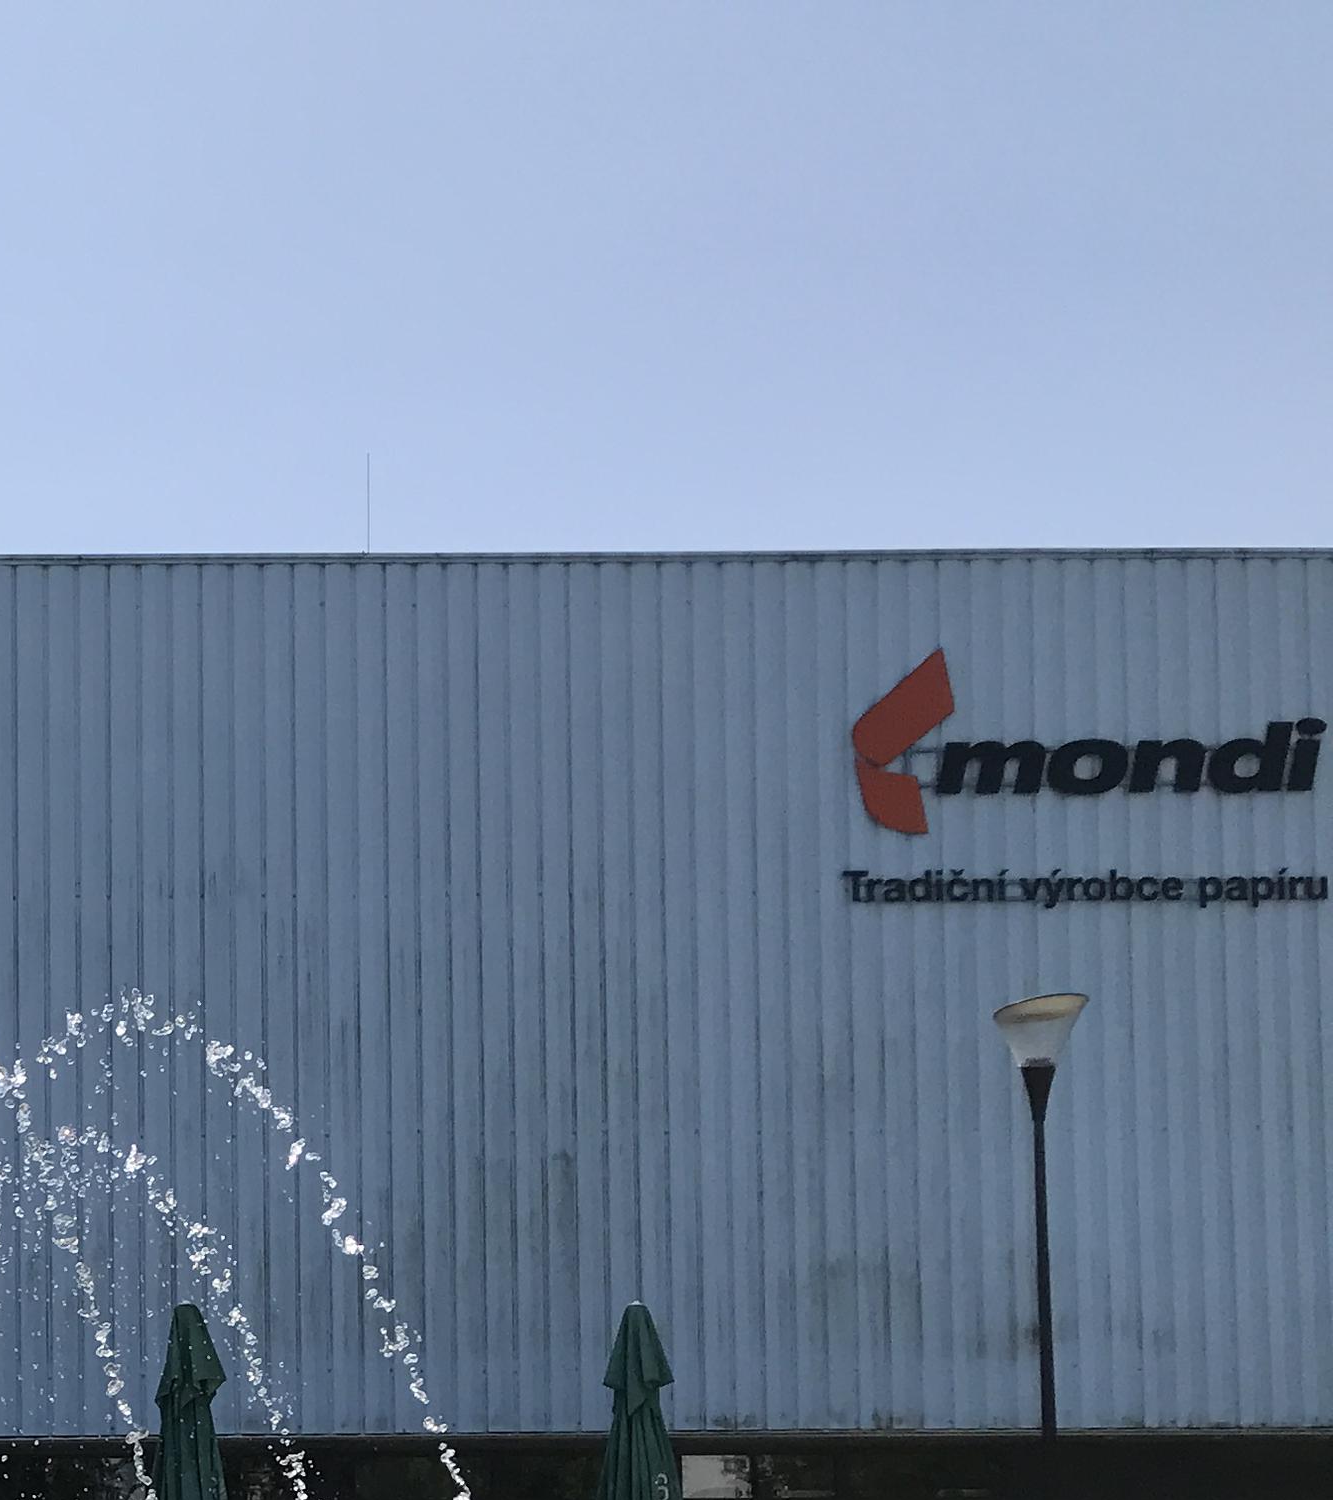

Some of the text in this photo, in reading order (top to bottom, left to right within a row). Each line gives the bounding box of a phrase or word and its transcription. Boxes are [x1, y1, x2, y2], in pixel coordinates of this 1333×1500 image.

[935, 717, 1327, 795] mondi
[842, 868, 1328, 908] Tradiční výrobce papíru
